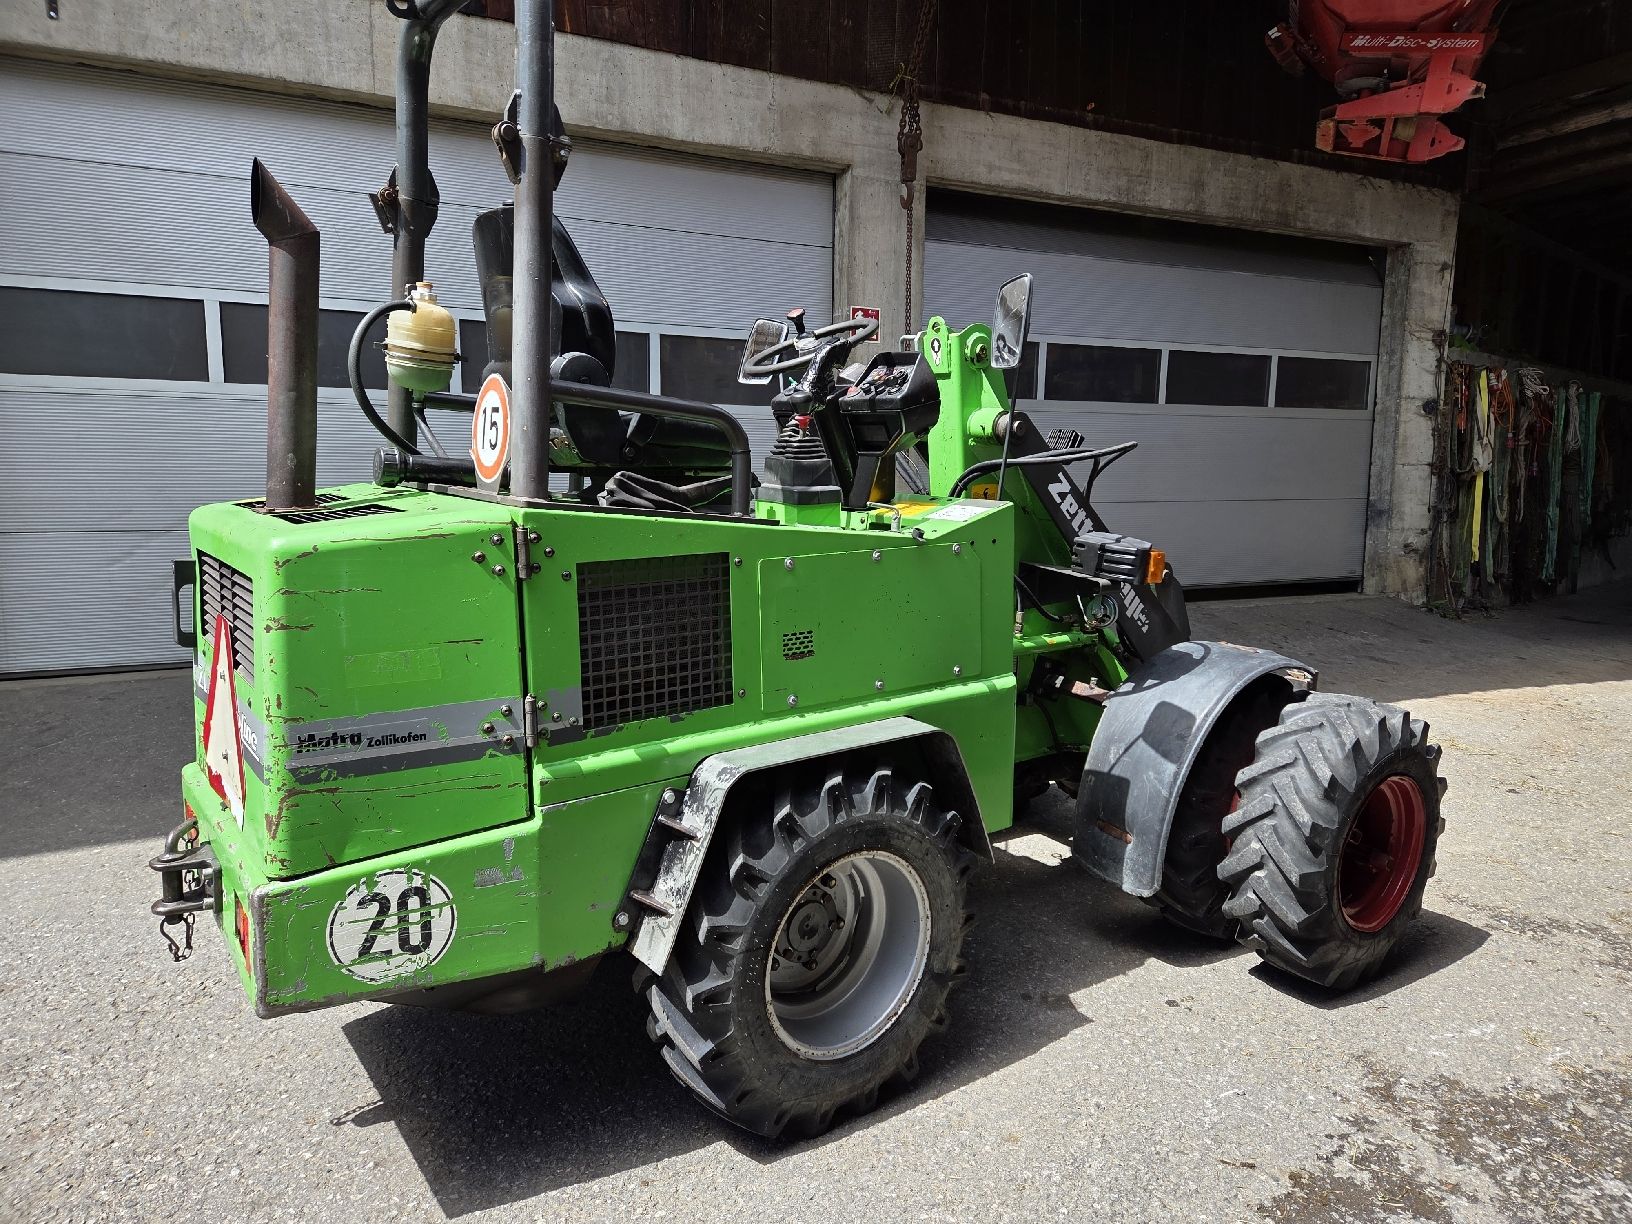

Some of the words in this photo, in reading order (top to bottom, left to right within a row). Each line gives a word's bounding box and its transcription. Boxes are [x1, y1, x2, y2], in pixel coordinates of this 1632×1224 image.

[1350, 35, 1480, 50] Multi-Disc-System
[481, 406, 500, 451] 15
[366, 732, 427, 748] Zollikofen
[356, 886, 432, 957] 20
